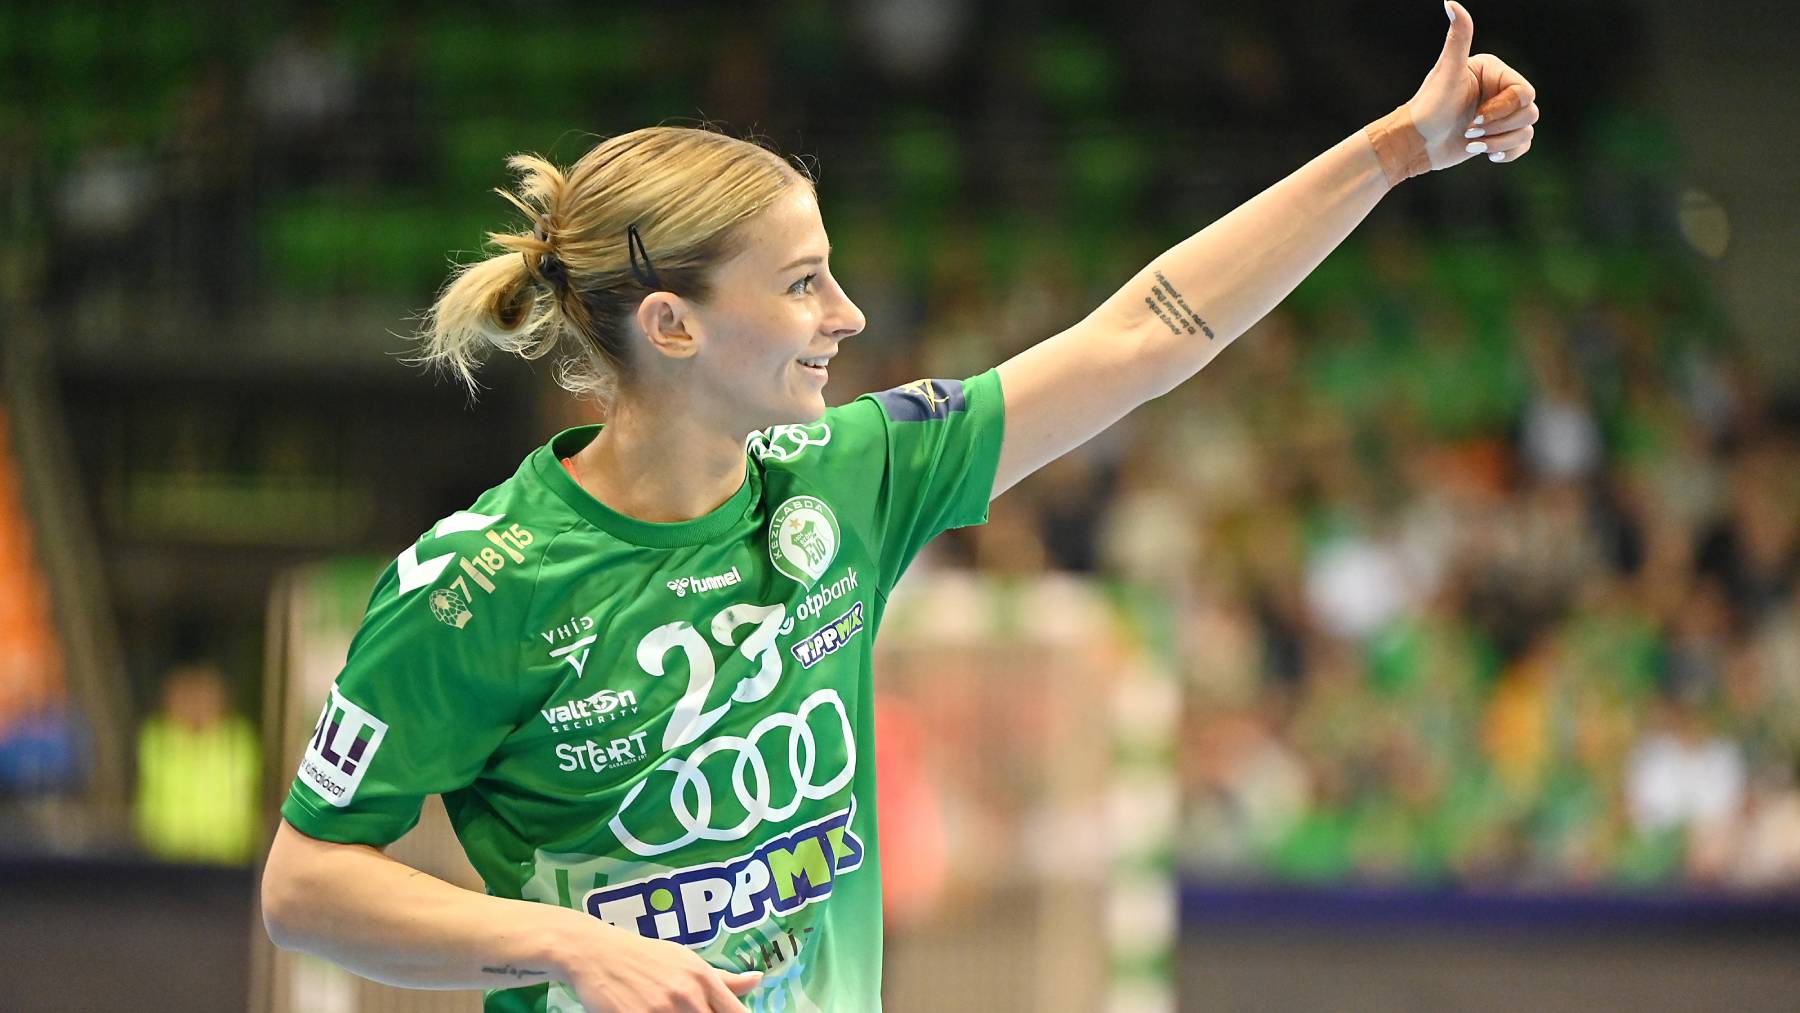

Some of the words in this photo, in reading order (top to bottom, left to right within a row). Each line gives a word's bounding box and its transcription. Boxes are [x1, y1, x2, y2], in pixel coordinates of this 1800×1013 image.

[690, 566, 742, 594] hummel
[636, 603, 786, 752] 23
[551, 706, 639, 733] SECURITY
